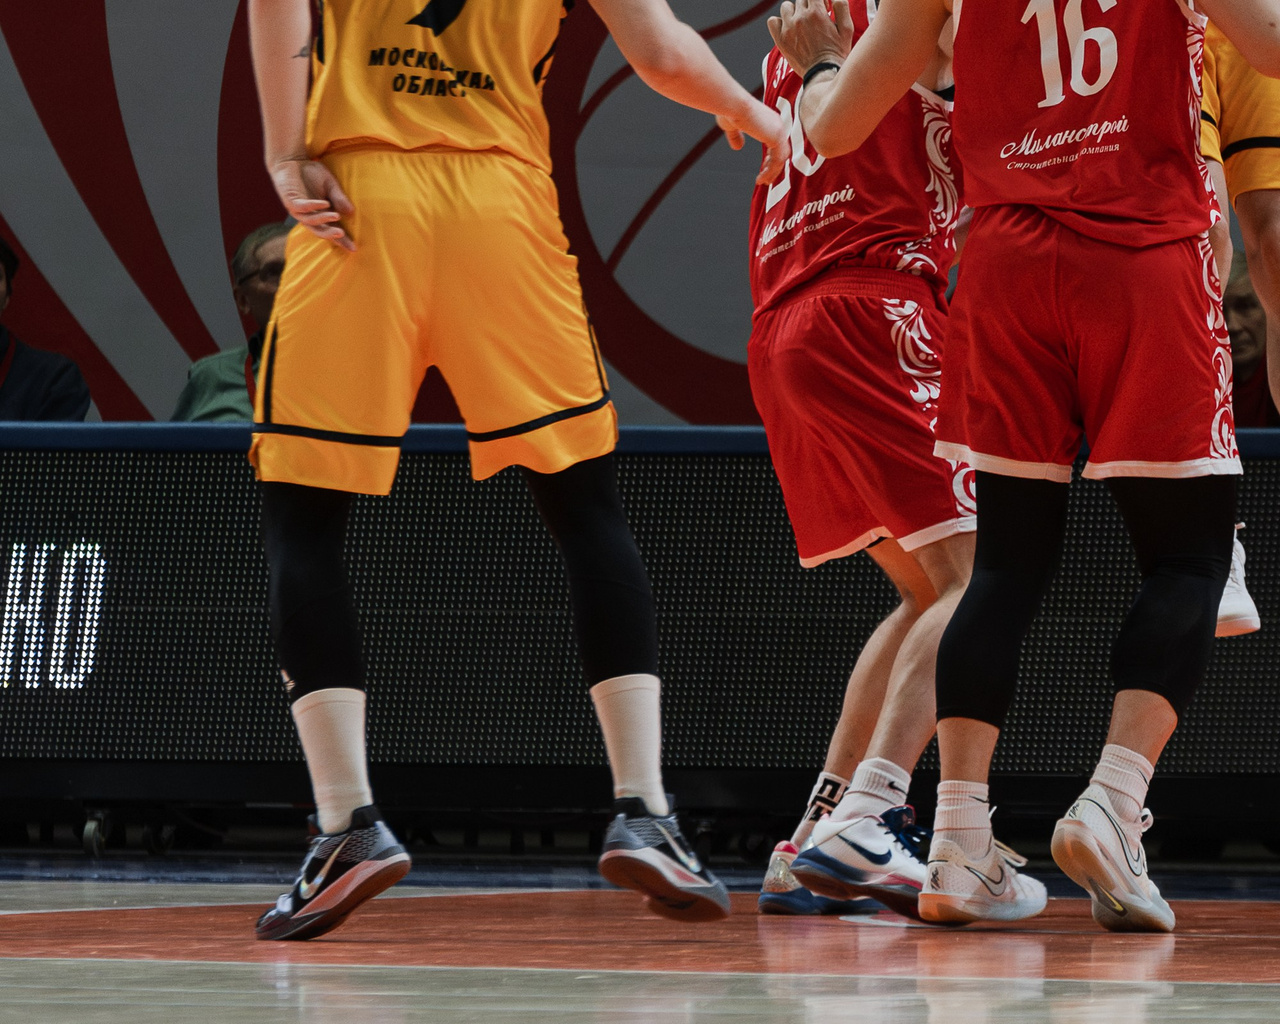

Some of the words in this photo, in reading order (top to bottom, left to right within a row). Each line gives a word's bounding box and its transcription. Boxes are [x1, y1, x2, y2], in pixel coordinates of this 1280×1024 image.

[367, 47, 495, 91] МОСКОКАЯ
[392, 73, 467, 97] ОБЛАС
[1079, 143, 1120, 156] омпания
